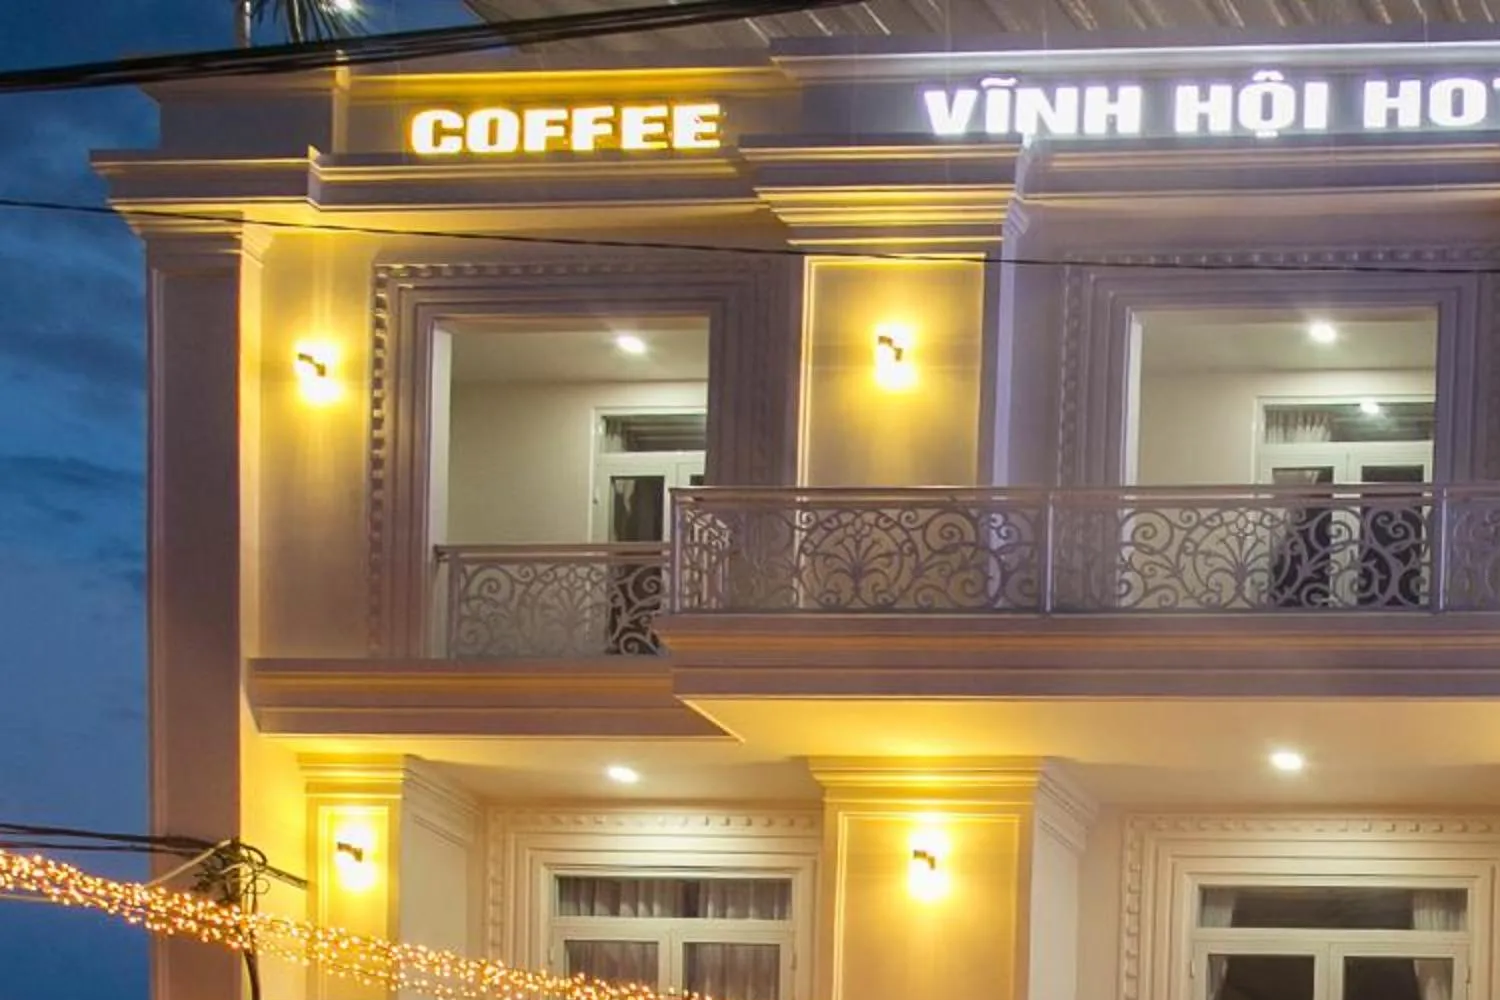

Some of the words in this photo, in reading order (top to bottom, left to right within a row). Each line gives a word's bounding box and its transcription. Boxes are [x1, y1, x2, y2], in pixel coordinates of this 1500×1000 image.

[410, 103, 723, 154] COFFEE
[924, 76, 1142, 136] VĨNH
[1175, 70, 1329, 139] HỘI
